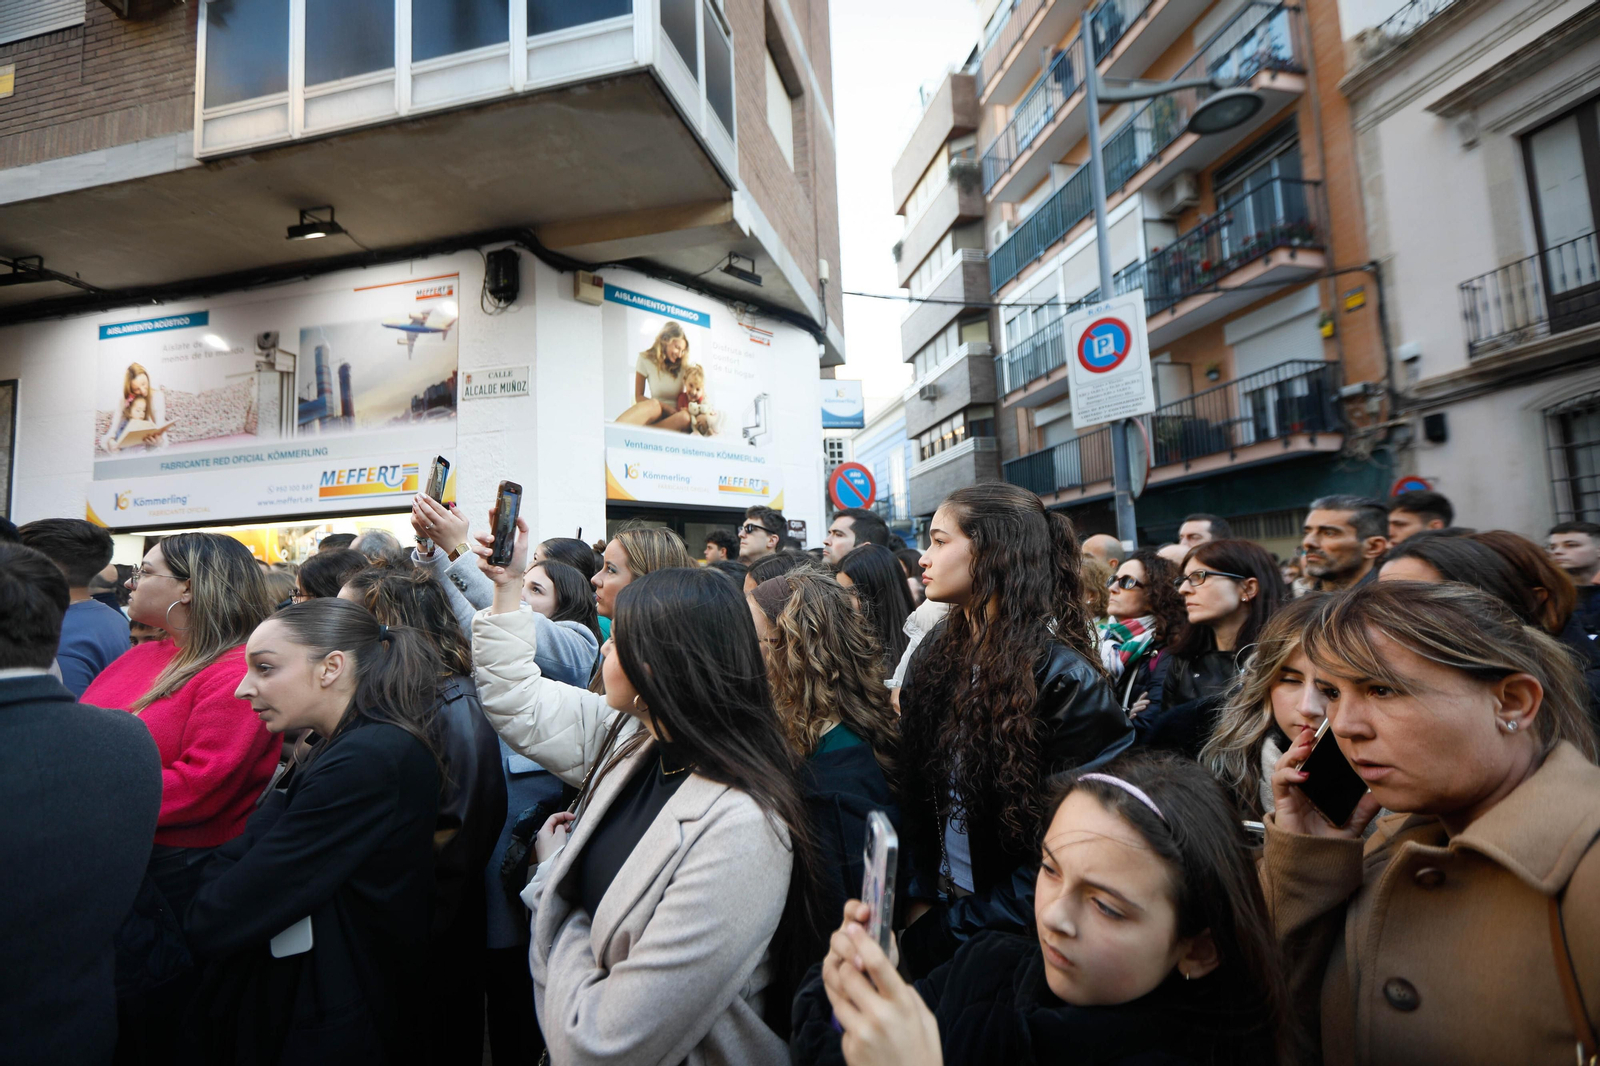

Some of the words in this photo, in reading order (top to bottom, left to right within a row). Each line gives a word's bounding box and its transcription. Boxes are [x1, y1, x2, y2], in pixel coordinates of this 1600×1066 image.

[615, 291, 666, 312] AISLAMIENTO
[666, 305, 699, 321] TÉRMICO
[106, 321, 153, 336] AISLAMIENTO
[154, 317, 190, 330] ACÚSTICO
[488, 370, 513, 379] CALLE
[465, 383, 497, 397] ALCALDE
[500, 379, 527, 394] MUÑOZ
[160, 458, 211, 471] FABRICANTE
[212, 457, 231, 466] RED
[232, 454, 265, 465] OFICIAL
[267, 446, 328, 461] KÖMMERLING
[624, 439, 663, 451] Ventanas
[664, 444, 680, 454] con
[681, 447, 715, 458] sistemas
[716, 450, 766, 464] KÖMMERLING
[319, 465, 403, 487] MEFFERT
[642, 470, 691, 484] Kömmerling
[718, 475, 761, 489] MEFFERT
[133, 494, 188, 507] Kömmerling
[257, 496, 313, 507] www.meffert.es
[149, 508, 185, 517] FABRICANTE
